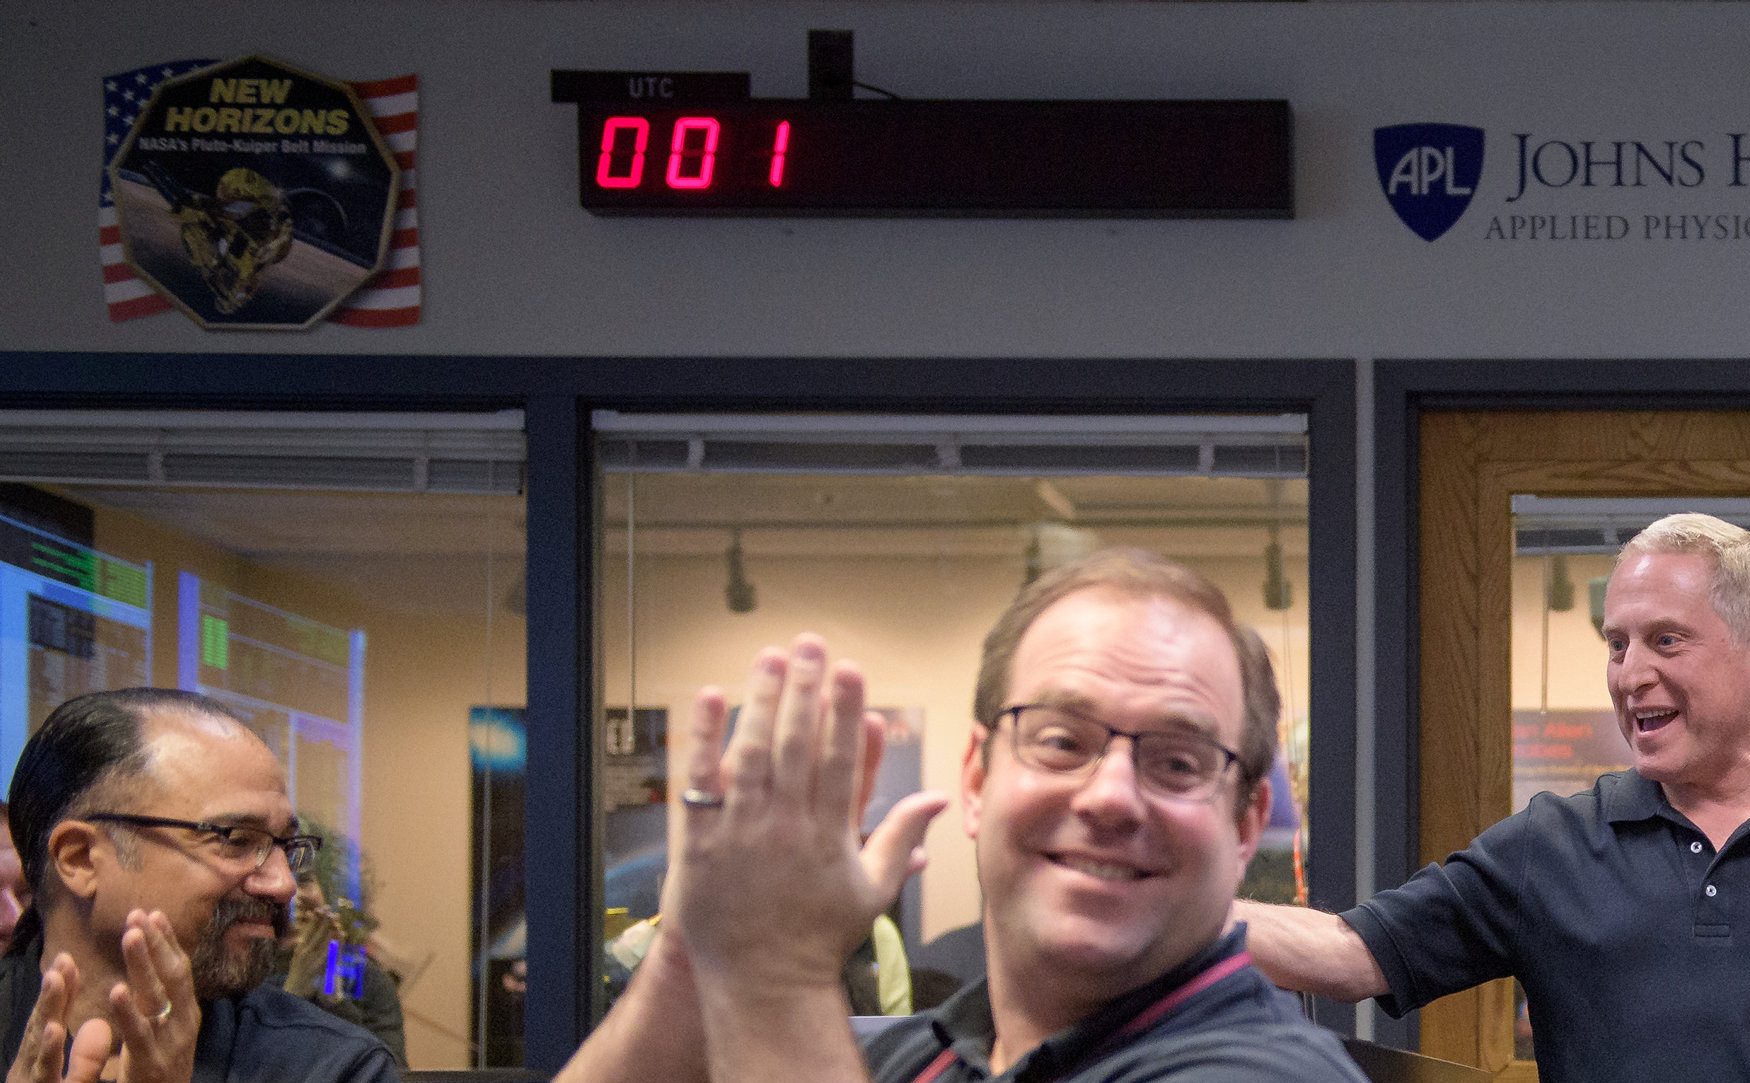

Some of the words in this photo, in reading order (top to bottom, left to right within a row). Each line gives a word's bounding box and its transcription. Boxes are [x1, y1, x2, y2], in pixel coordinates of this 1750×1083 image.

[208, 78, 294, 105] NEW
[628, 77, 674, 98] UTC
[163, 106, 351, 135] HORIZONS
[138, 136, 188, 152] NASA's
[281, 139, 310, 153] Belt
[312, 140, 367, 155] Mission
[1388, 145, 1472, 197] APL
[1505, 132, 1705, 203] JOHNS
[1484, 213, 1630, 242] APPLIED
